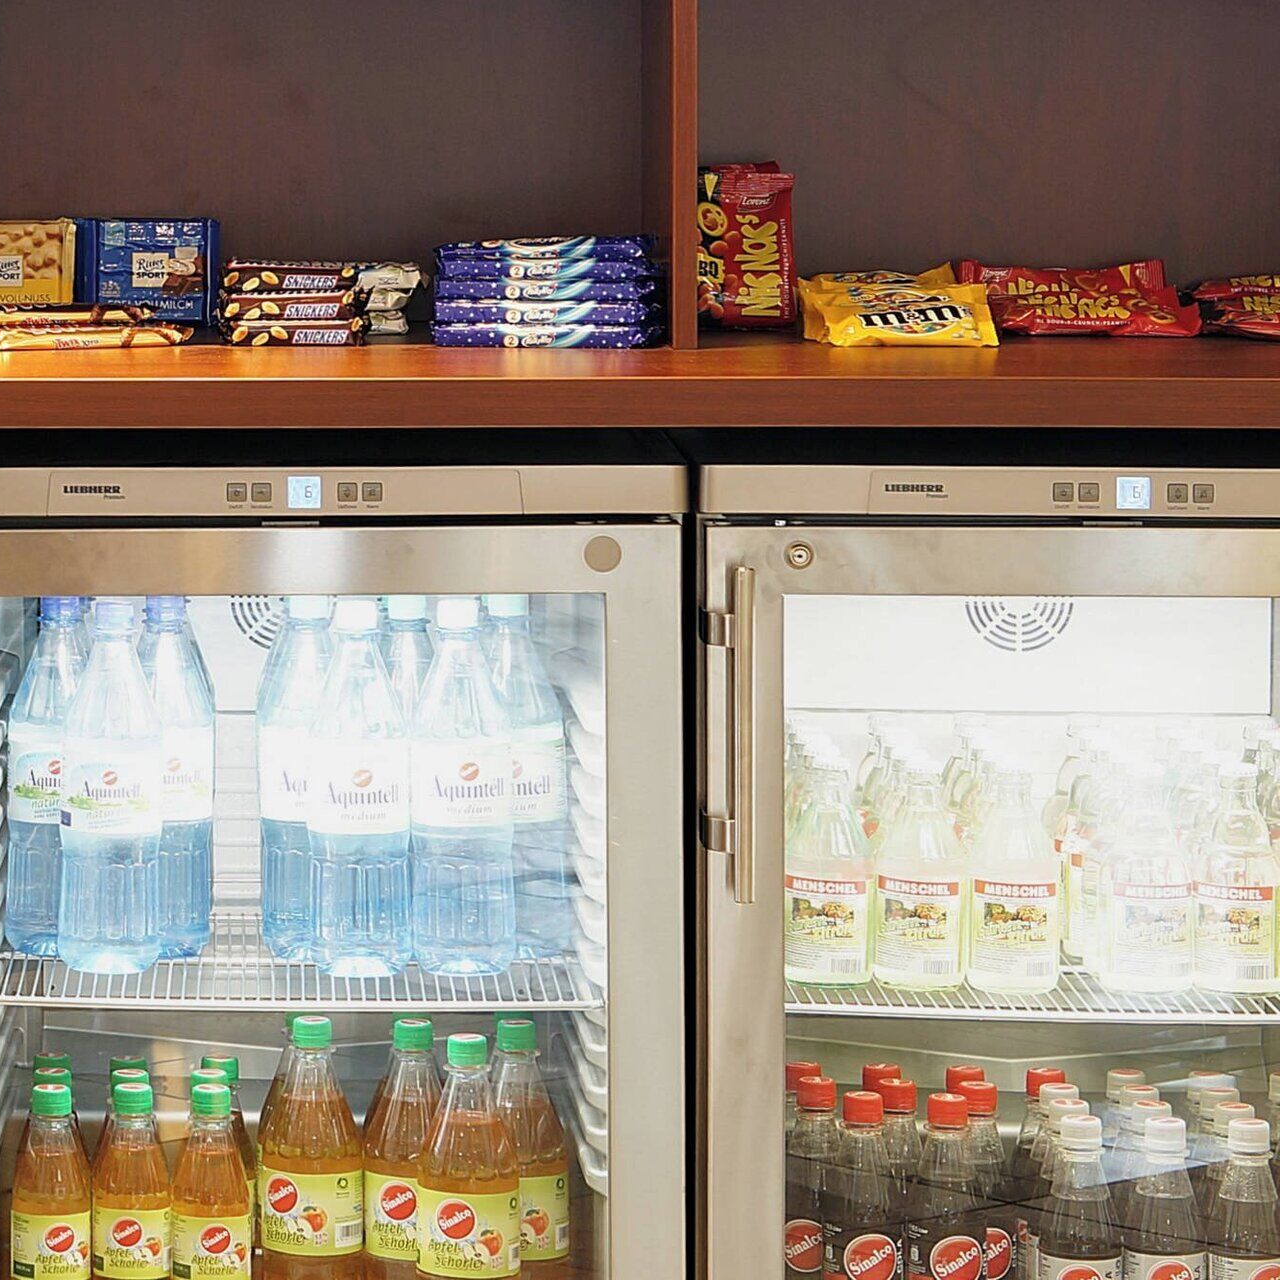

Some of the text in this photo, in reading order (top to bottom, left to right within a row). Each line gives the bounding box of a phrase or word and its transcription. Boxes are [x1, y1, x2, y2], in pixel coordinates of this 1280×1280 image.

[742, 197, 772, 206] Lorenz
[136, 258, 165, 270] Ritter
[135, 271, 165, 279] SPORT
[285, 276, 336, 288] SNICKERS
[286, 305, 337, 317] SNICKERS
[295, 331, 346, 343] SNICKERS
[63, 485, 121, 494] LIEBHERR
[885, 484, 944, 493] LIEBHERR
[432, 777, 504, 802] Aquintell
[792, 879, 858, 894] MENSCHEL
[885, 880, 951, 896] MENSCHEL
[984, 884, 1049, 898] MENSCHEL
[1198, 884, 1263, 900] MENSCHEL
[268, 1182, 296, 1204] Sinalco
[382, 1190, 415, 1213] Sinalco
[438, 1209, 473, 1231] Sinalco
[44, 1228, 75, 1247] Sinalco
[112, 1224, 140, 1241] Sinalco
[201, 1231, 229, 1248] Sinalco
[266, 1229, 306, 1245] Schorle
[42, 1263, 77, 1274] Schorle
[110, 1258, 145, 1268] Schorle
[435, 1254, 482, 1269] Schorle
[849, 1246, 893, 1276] Sinalco
[936, 1246, 978, 1277] Sinalco
[198, 1264, 234, 1275] Schorle
